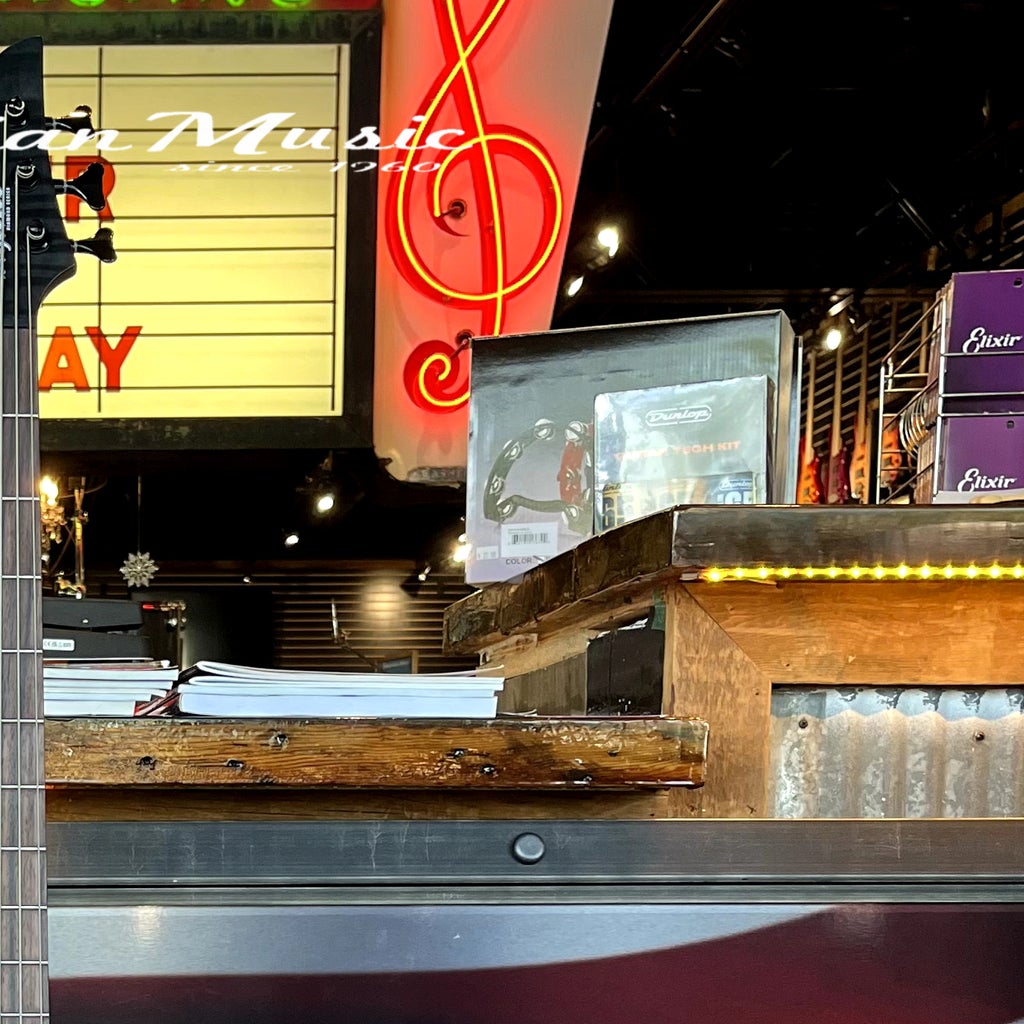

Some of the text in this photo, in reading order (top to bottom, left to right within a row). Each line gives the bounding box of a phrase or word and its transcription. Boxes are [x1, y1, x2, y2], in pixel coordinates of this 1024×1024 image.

[962, 326, 1023, 354] Elixir
[647, 407, 711, 424] Dunlop
[717, 440, 742, 452] KIT
[957, 467, 1018, 493] Elixir
